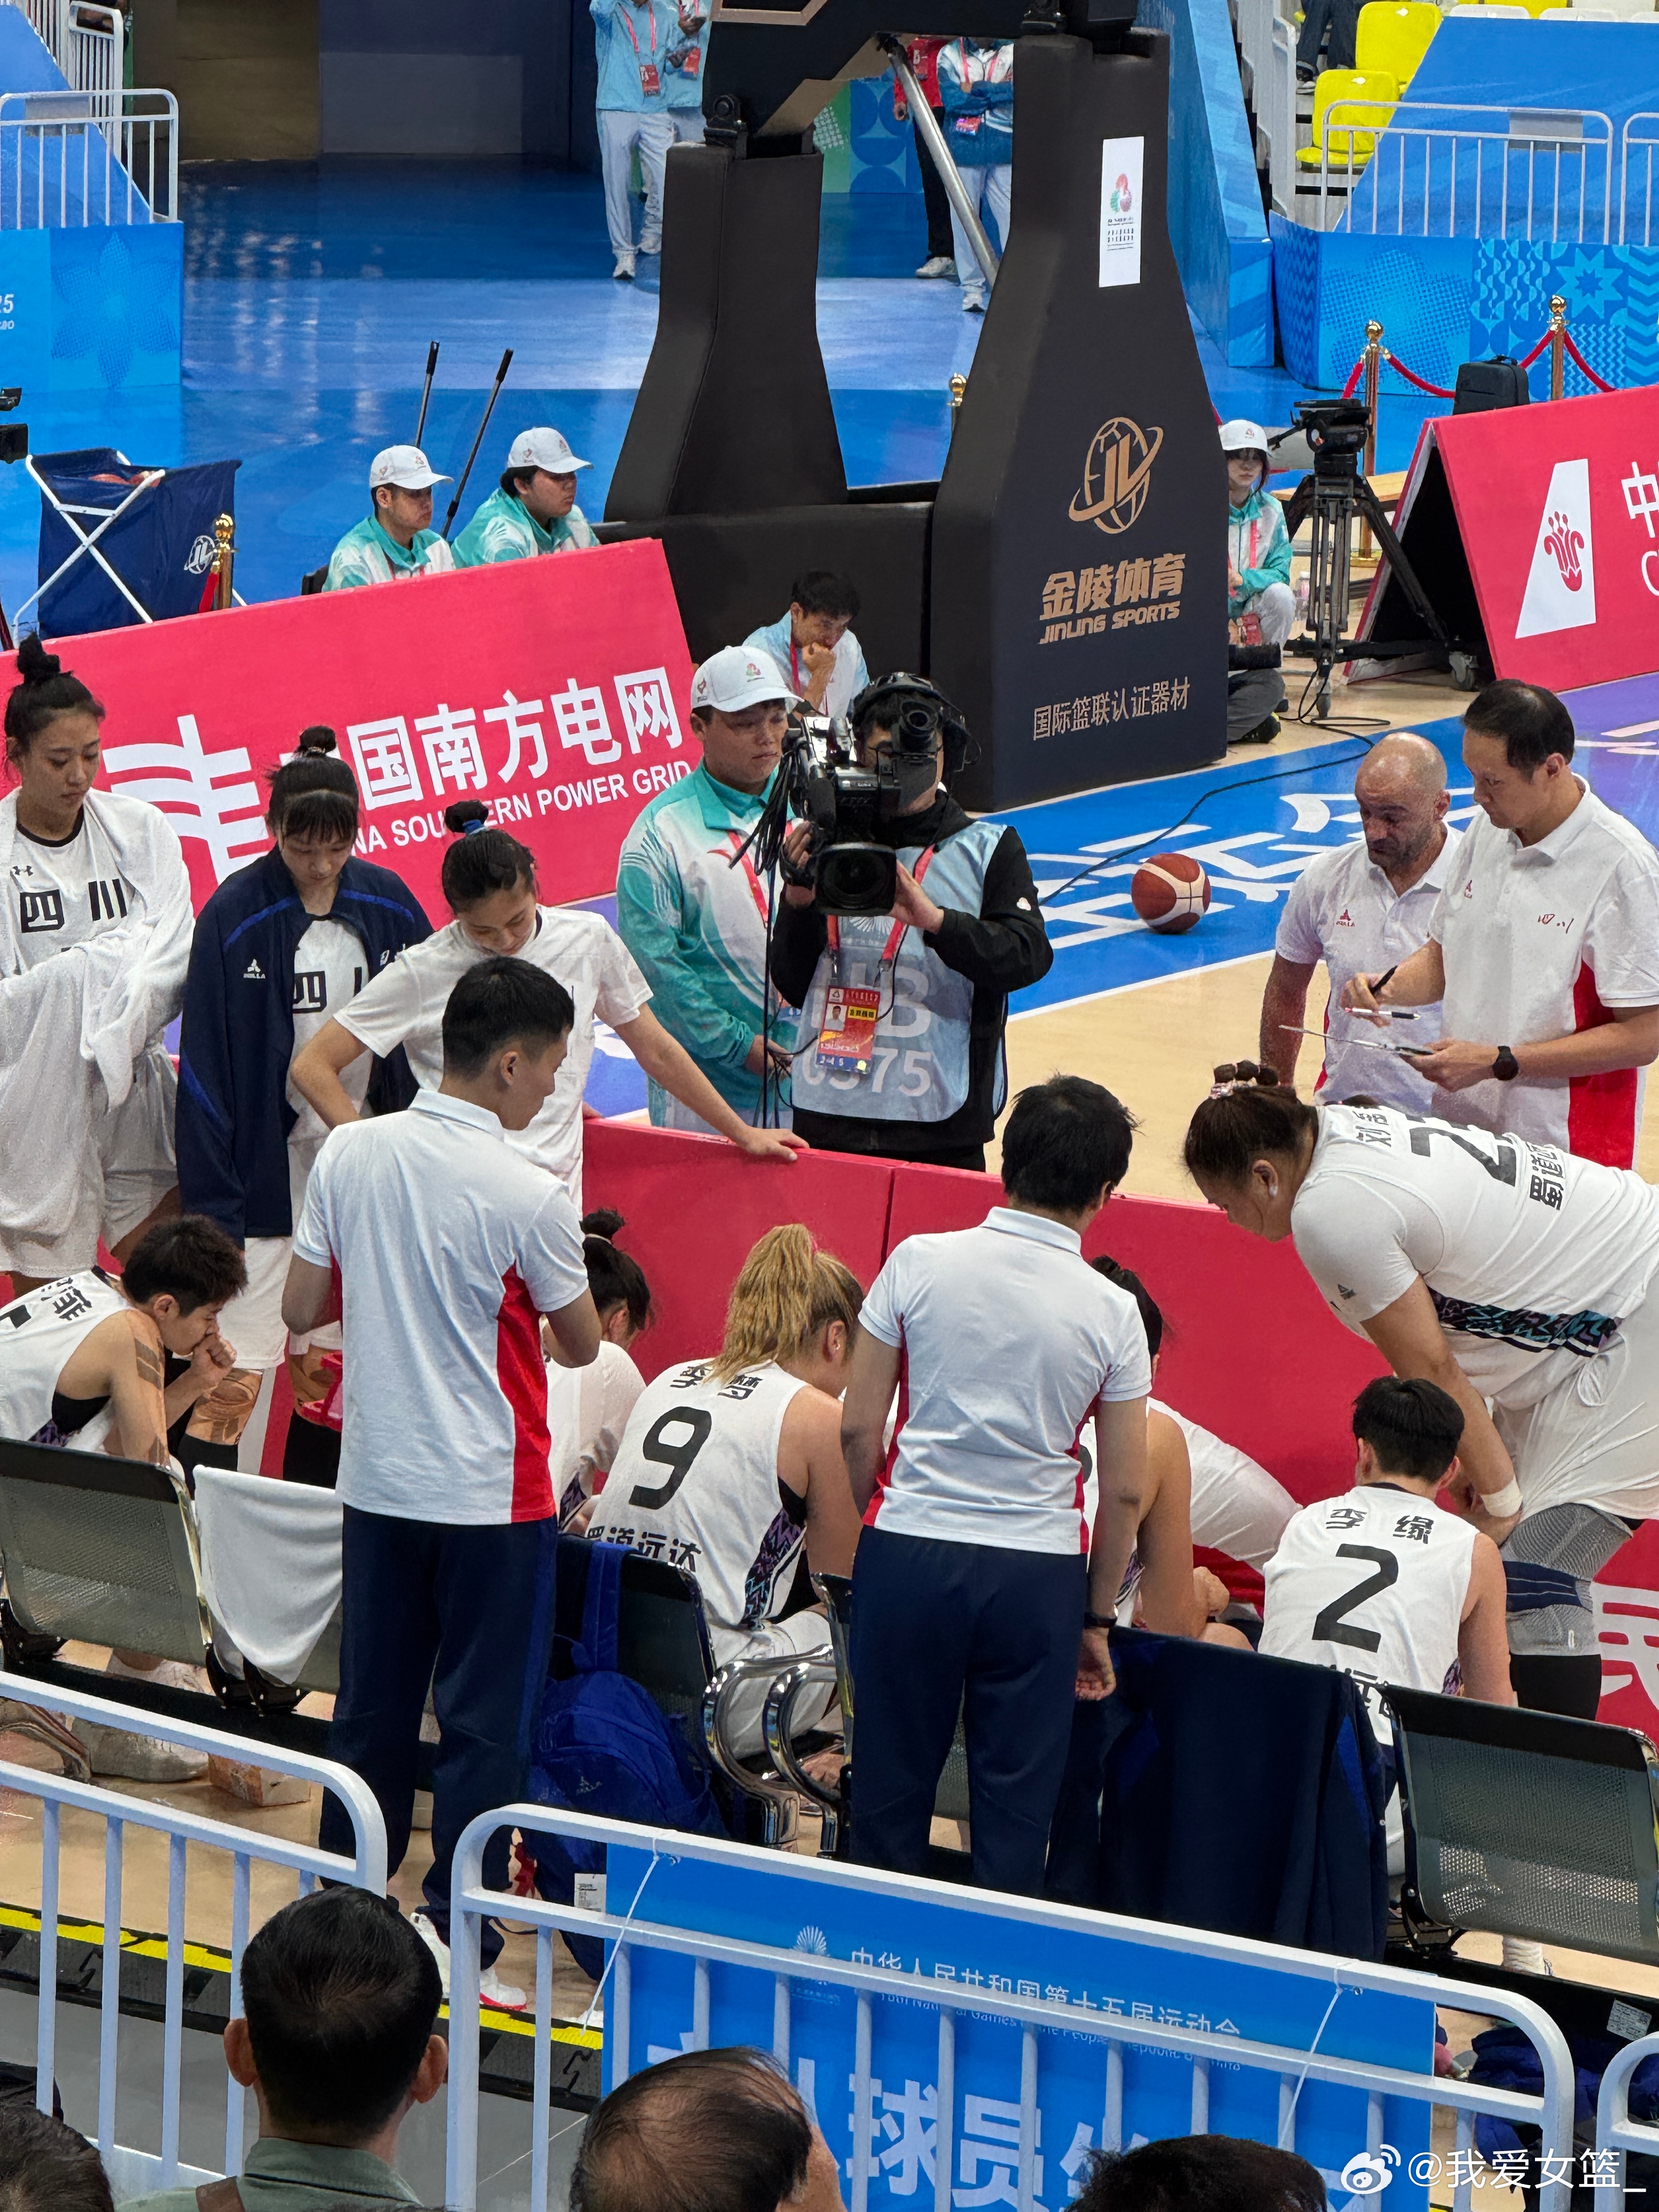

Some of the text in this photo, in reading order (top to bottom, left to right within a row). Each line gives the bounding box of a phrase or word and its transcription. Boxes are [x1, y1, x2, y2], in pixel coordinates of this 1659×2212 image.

[0, 294, 14, 314] 5
[1040, 553, 1186, 620] 金陵体育
[1037, 601, 1181, 645] JINLING SPORTS
[279, 666, 683, 811] 国南方电网
[1033, 676, 1190, 741] 国际篮联认证器材
[538, 774, 624, 816] POWER
[633, 760, 691, 795] GRID
[20, 879, 127, 933] 四川
[629, 1406, 712, 1510] 9
[1312, 1543, 1399, 1653] 2
